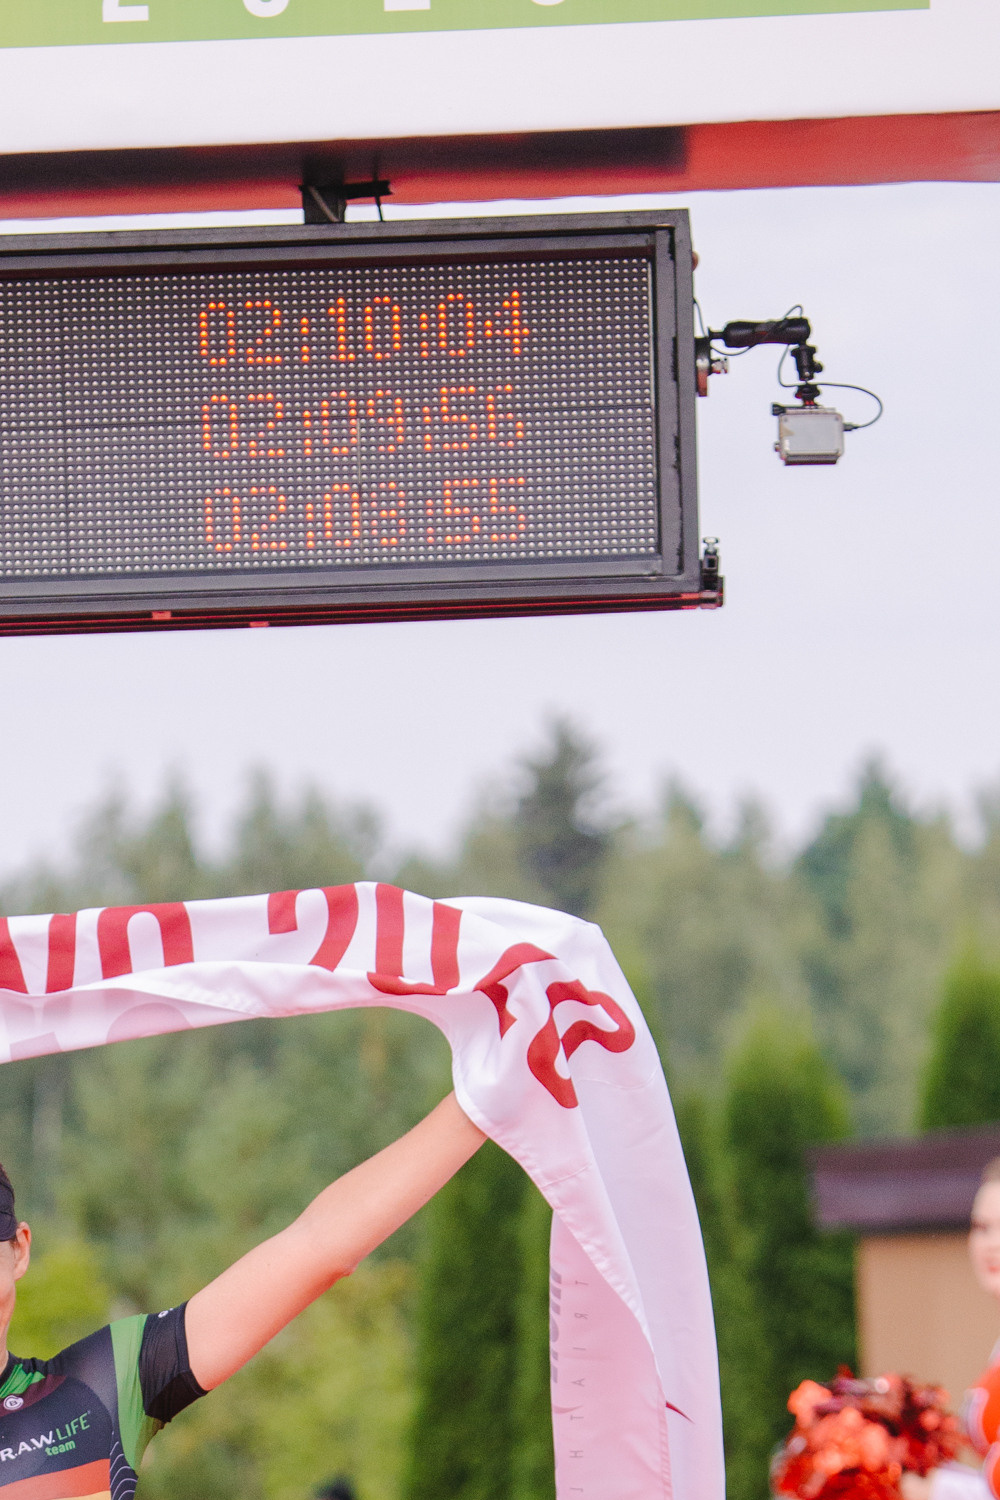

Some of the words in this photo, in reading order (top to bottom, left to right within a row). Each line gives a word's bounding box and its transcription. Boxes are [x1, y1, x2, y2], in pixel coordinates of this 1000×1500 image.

[198, 289, 531, 367] 02:10:04
[200, 383, 526, 459] 02:09:56
[203, 476, 528, 552] 02:08:55
[45, 1440, 77, 1457] team
[55, 1411, 91, 1441] LIFE
